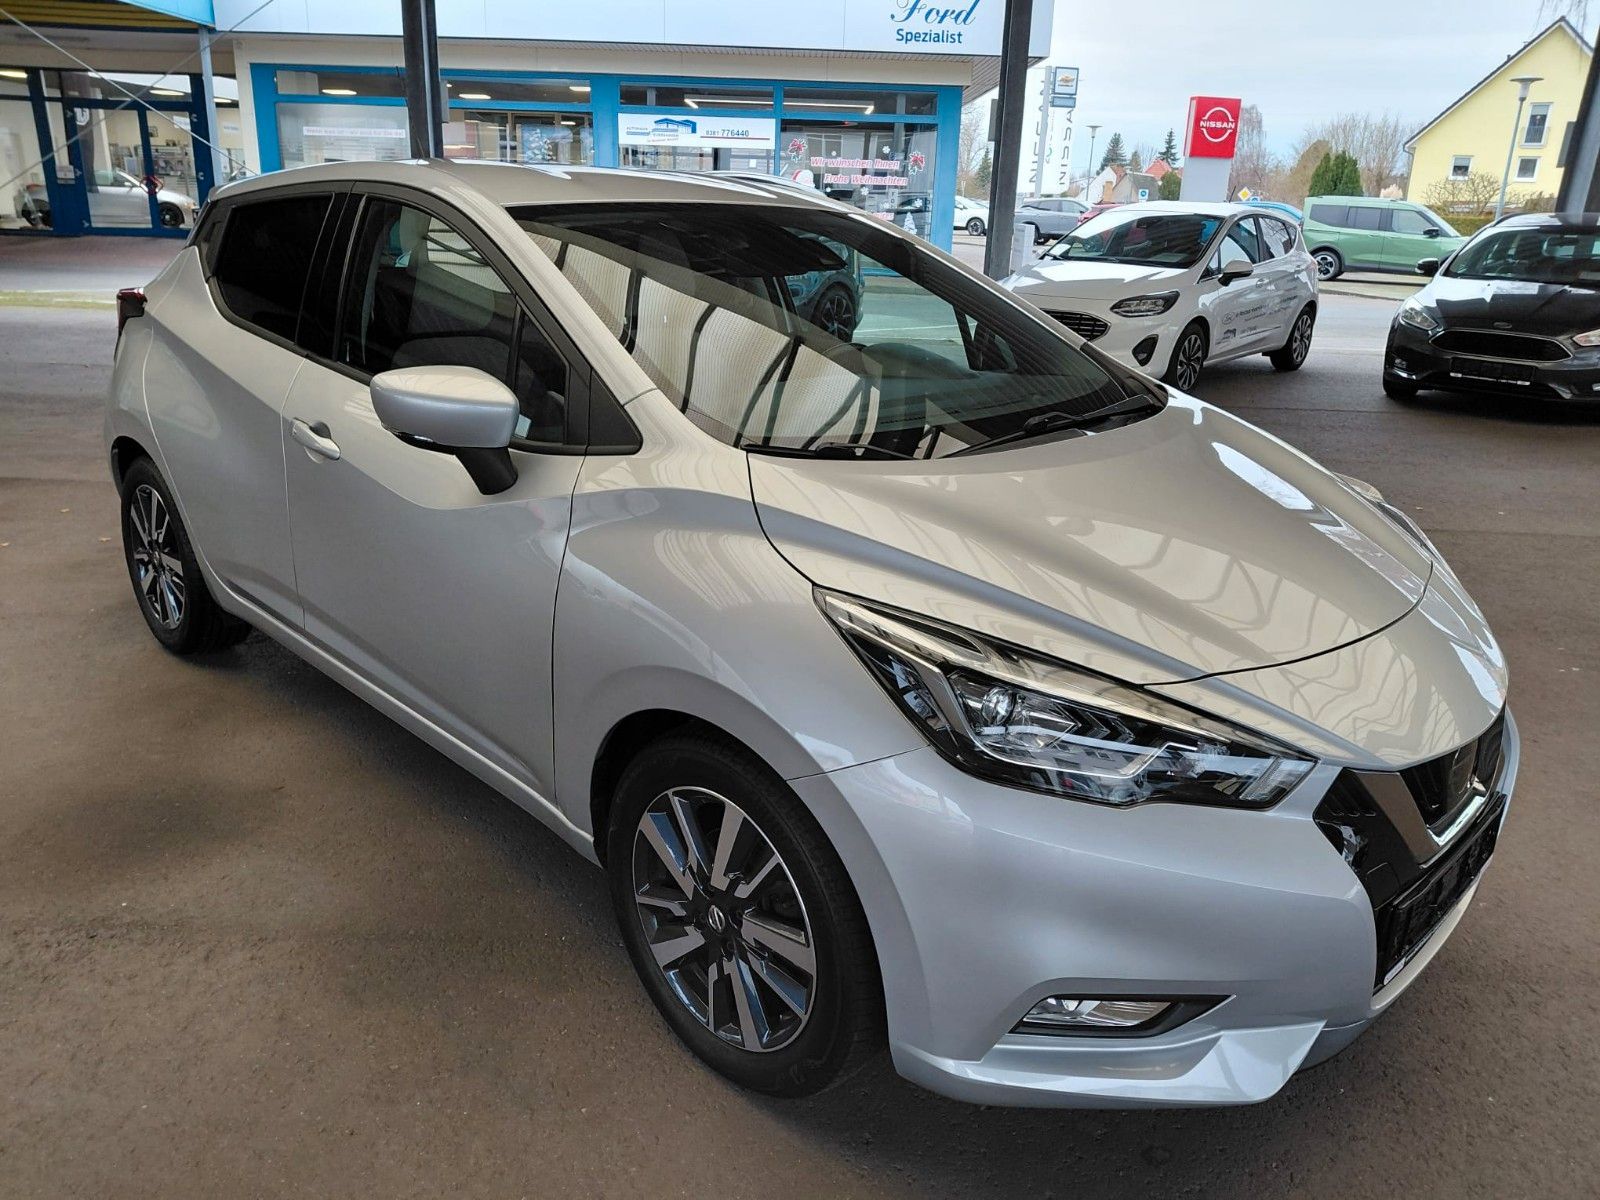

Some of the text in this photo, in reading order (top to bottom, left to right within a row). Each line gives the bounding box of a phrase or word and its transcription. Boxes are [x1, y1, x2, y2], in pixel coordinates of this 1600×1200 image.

[890, 0, 980, 25] Ford
[896, 28, 963, 44] Spezialist
[1199, 120, 1235, 129] NISSAN
[721, 129, 750, 137] 776440
[1058, 107, 1075, 185] NISSA
[811, 157, 899, 169] Wir wünschen Ihnen
[851, 175, 908, 186] Weihnachten
